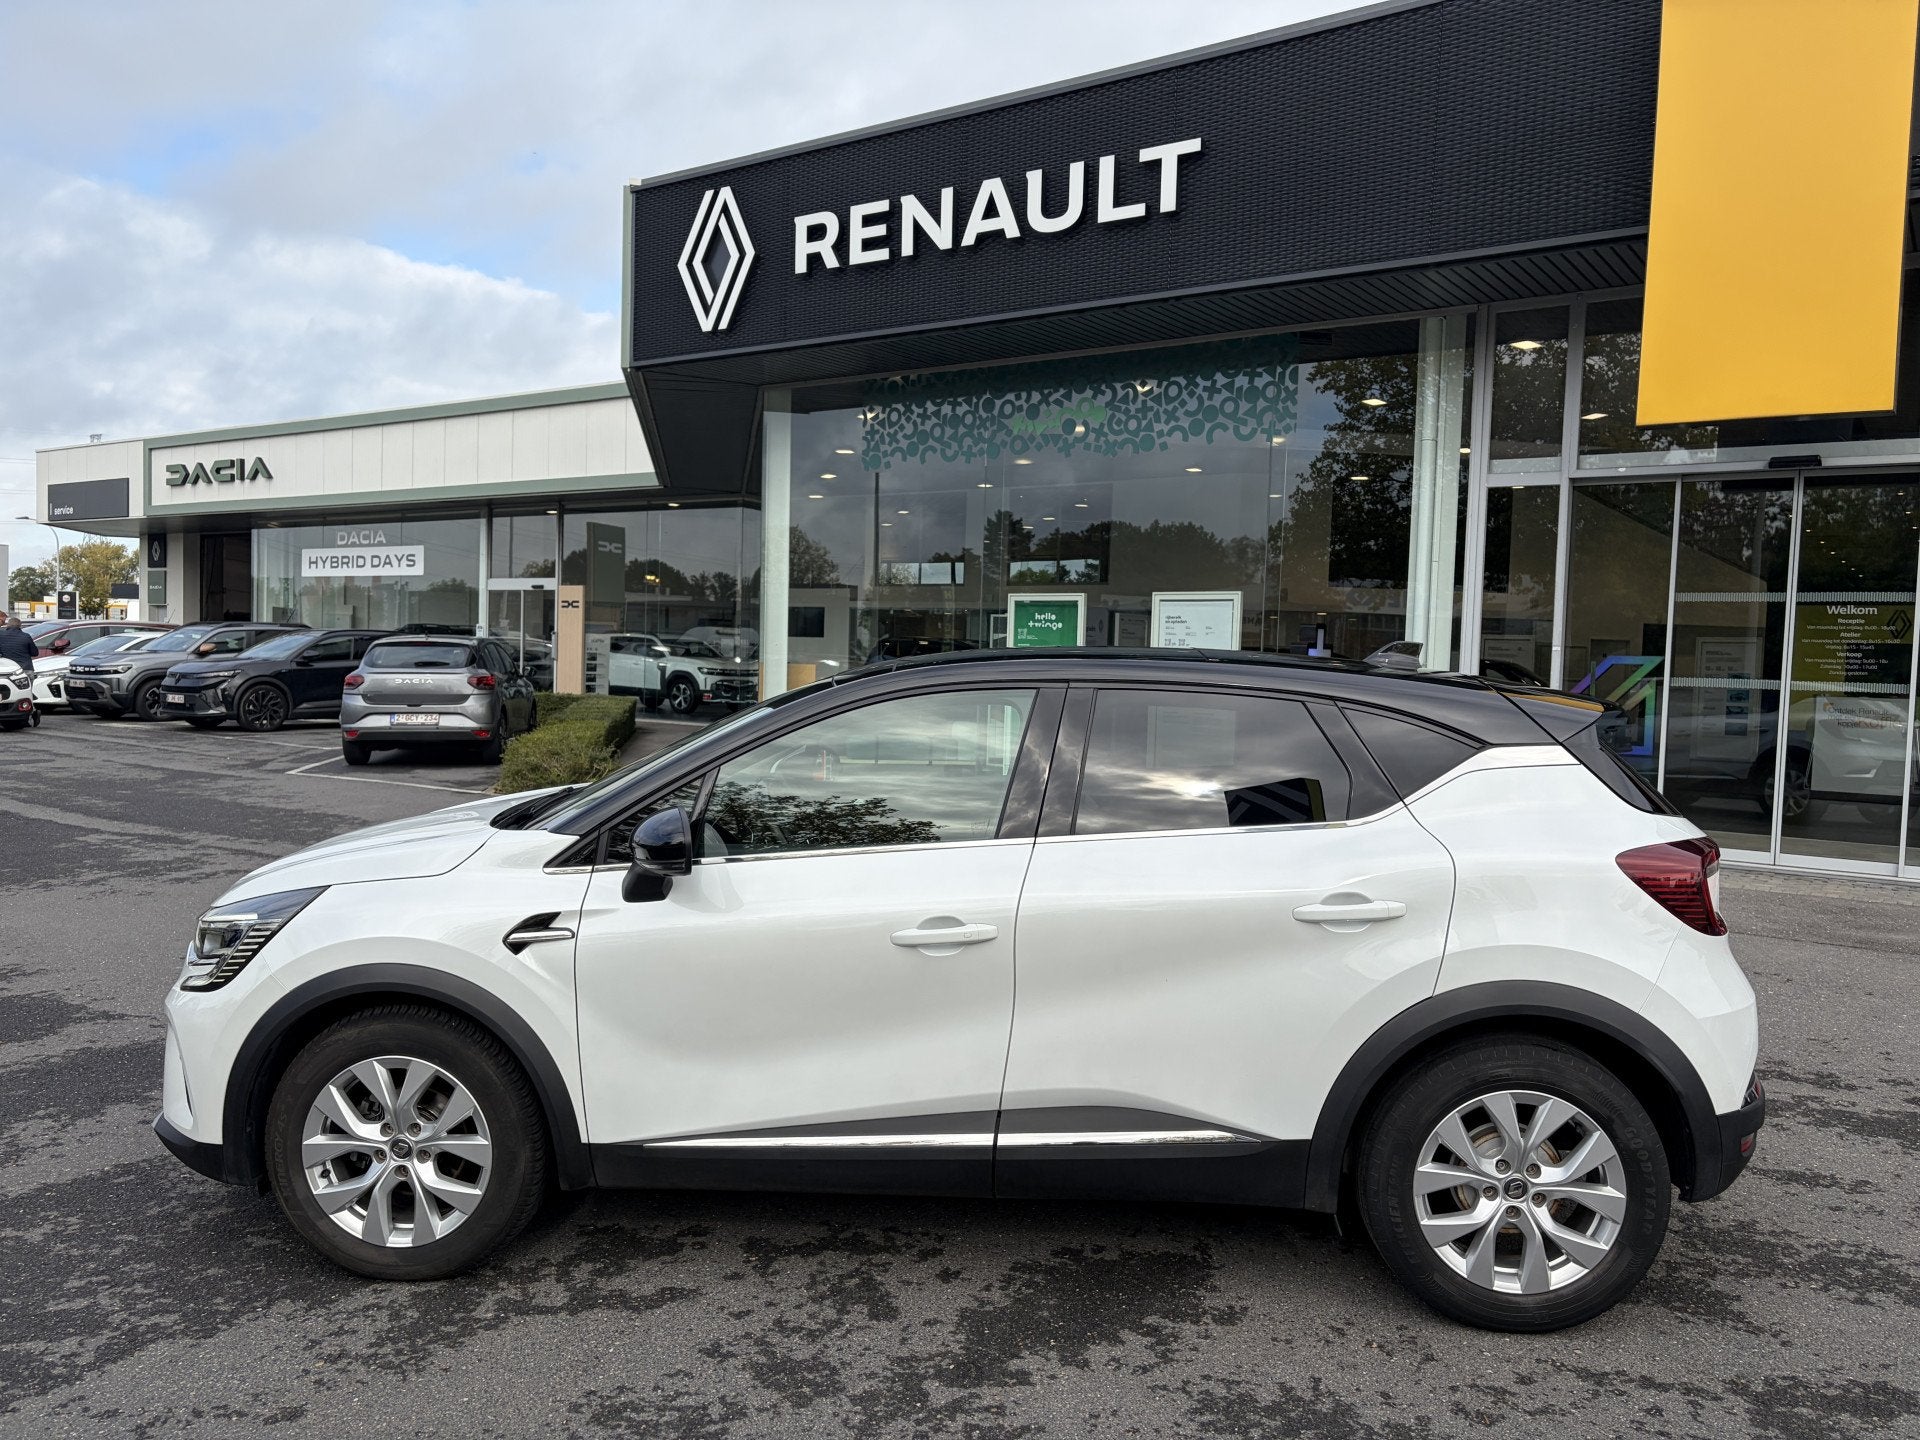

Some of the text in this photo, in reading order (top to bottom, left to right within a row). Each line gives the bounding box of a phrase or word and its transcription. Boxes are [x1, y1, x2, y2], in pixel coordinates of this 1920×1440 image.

[794, 138, 1202, 274] RENAULT
[166, 457, 273, 486] DACIA
[54, 505, 73, 515] service
[337, 530, 386, 545] DACIA
[308, 554, 416, 569] HYBRID DAYS
[1035, 612, 1056, 620] hello
[1826, 605, 1878, 615] Welkom
[1028, 620, 1063, 631] twingo
[1624, 1126, 1656, 1234] GOODYEAR
